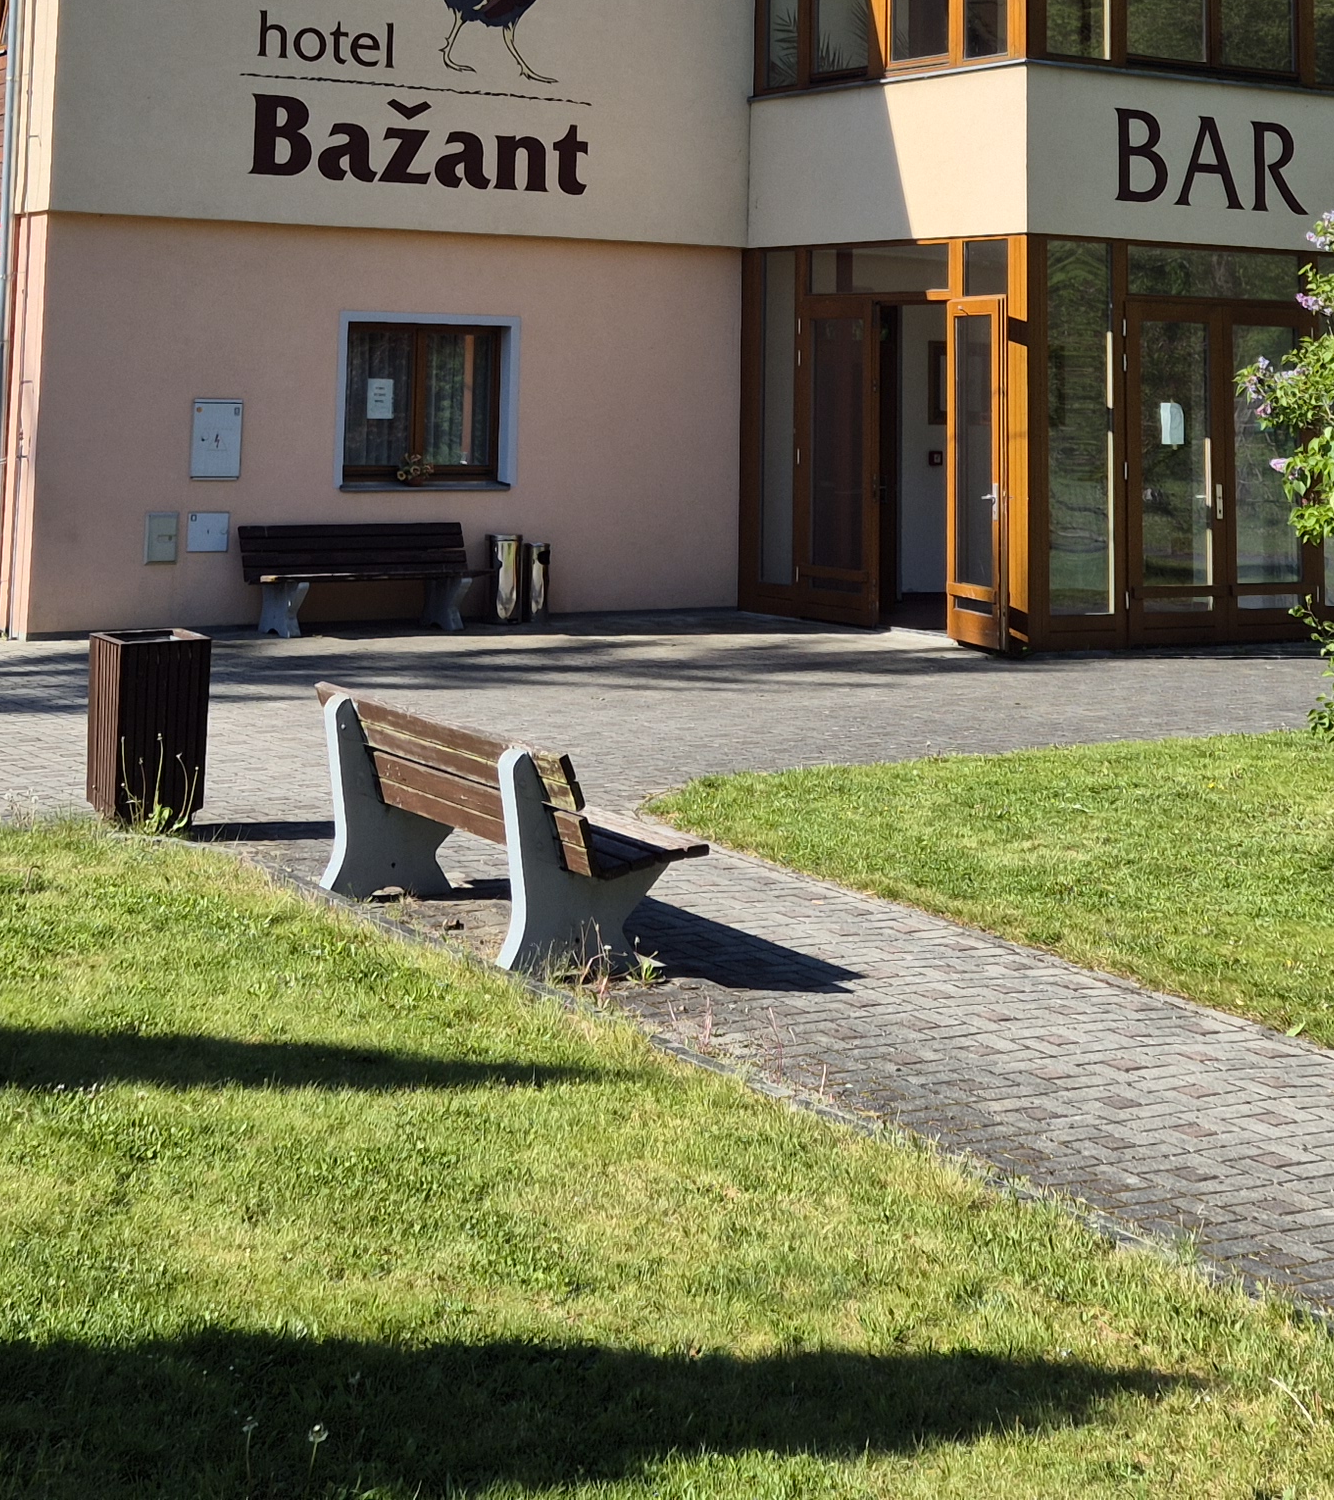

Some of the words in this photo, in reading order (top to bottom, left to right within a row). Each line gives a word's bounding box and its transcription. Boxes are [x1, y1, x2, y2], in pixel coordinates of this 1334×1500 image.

[256, 9, 395, 69] hotel
[247, 92, 589, 196] Bažant
[1113, 107, 1309, 216] BAR
